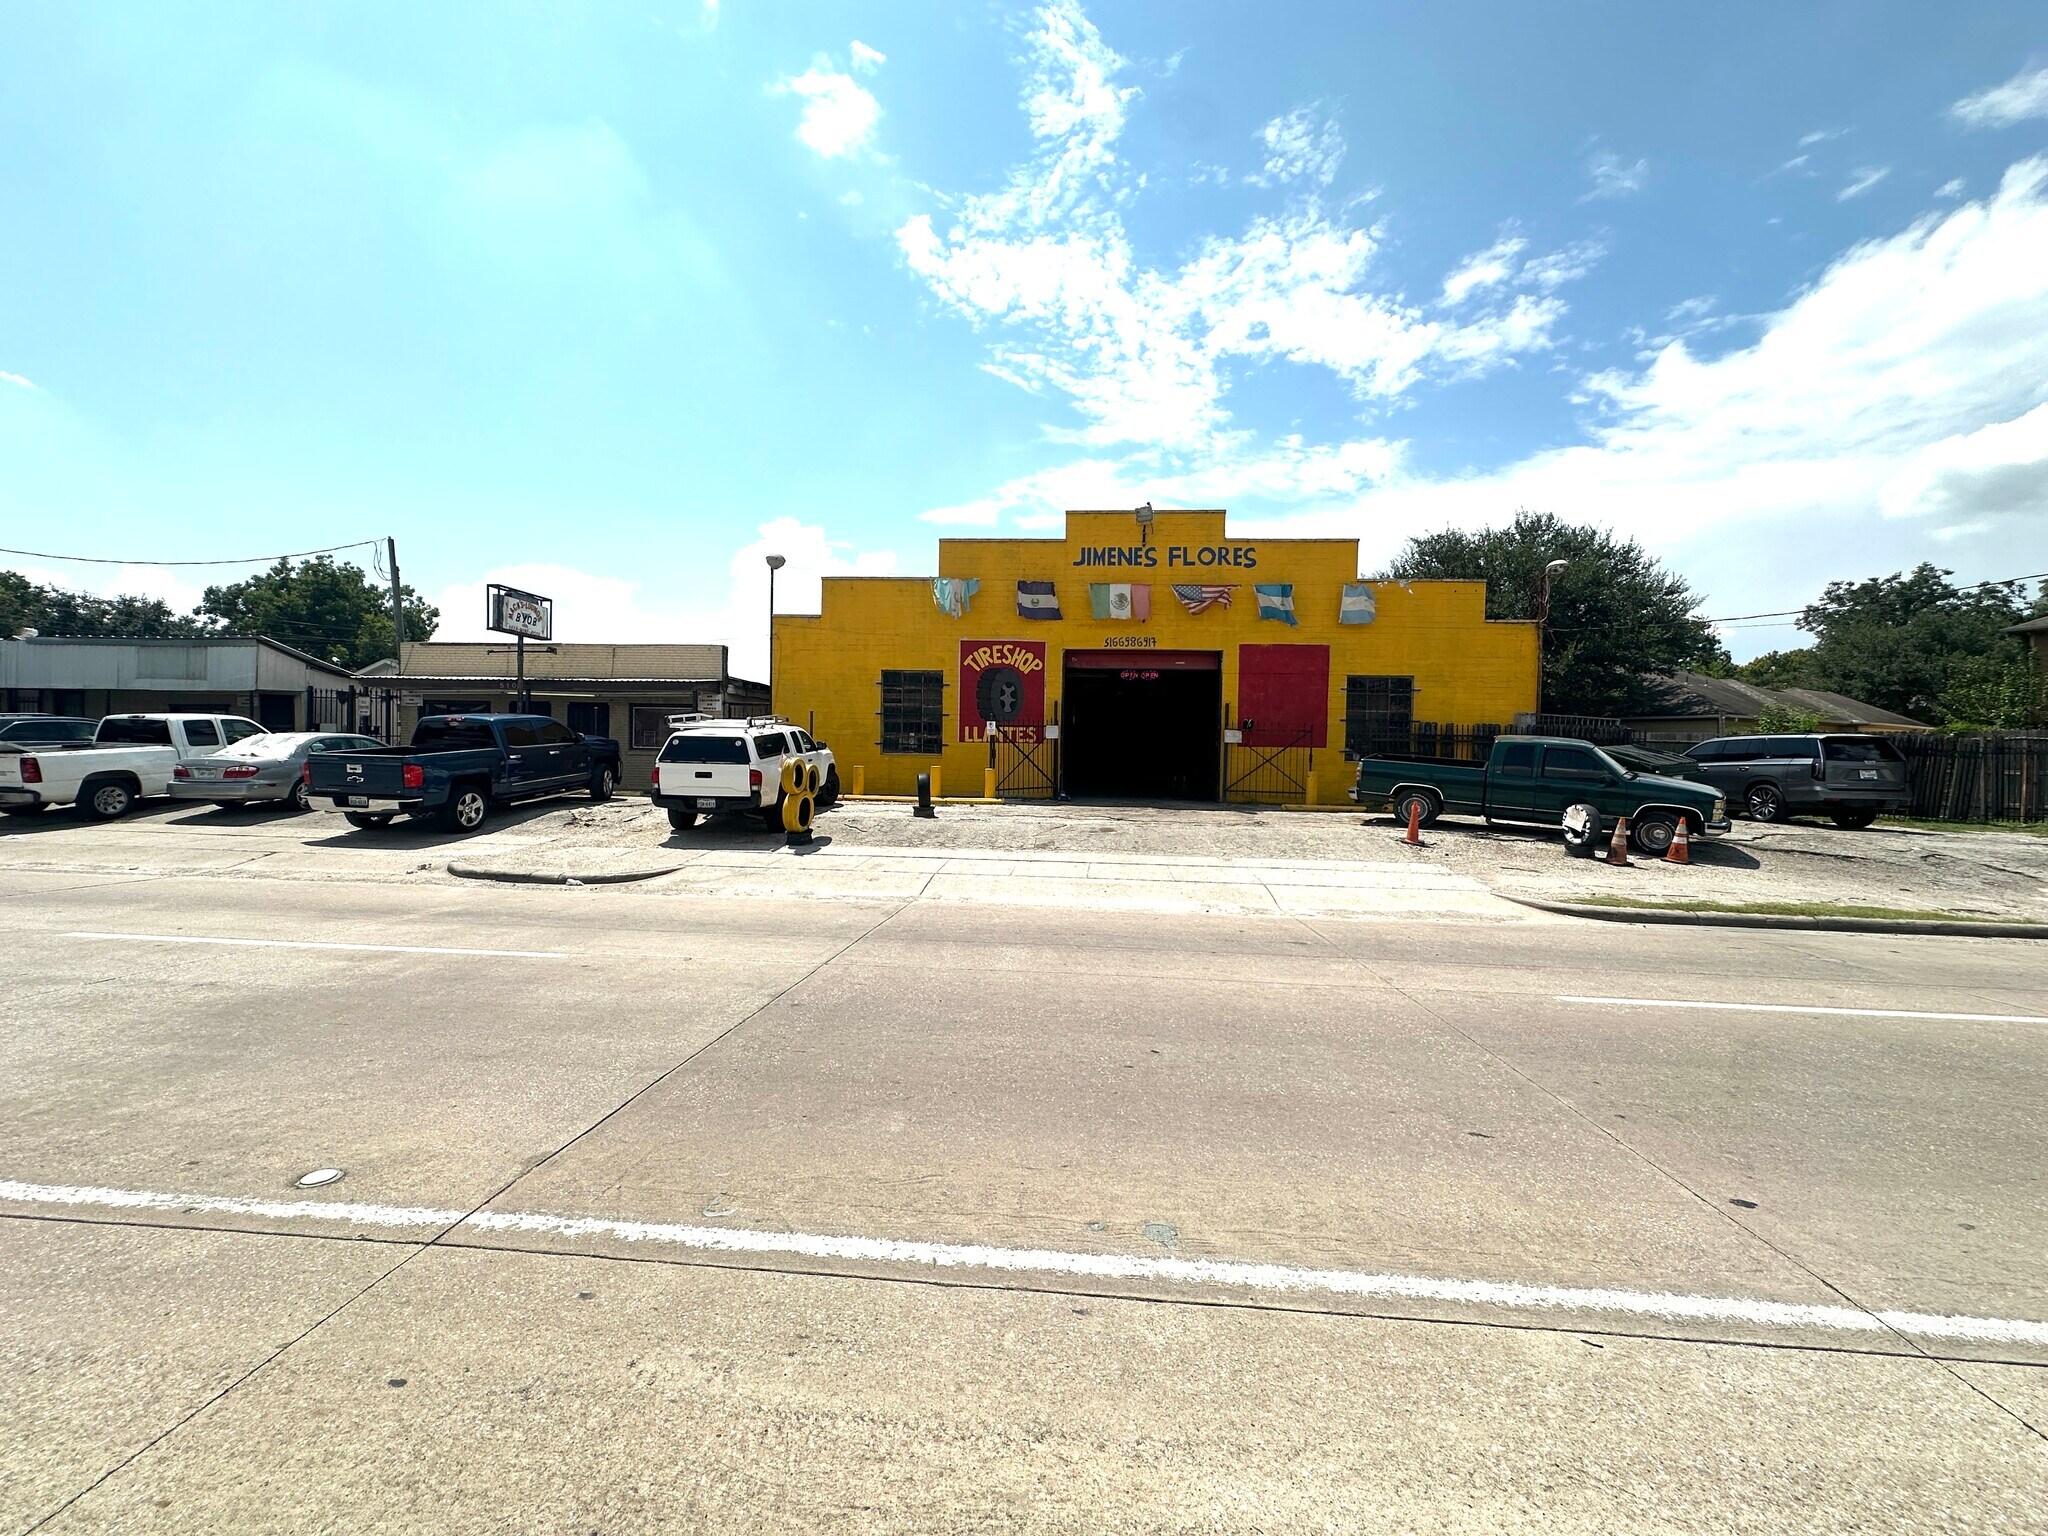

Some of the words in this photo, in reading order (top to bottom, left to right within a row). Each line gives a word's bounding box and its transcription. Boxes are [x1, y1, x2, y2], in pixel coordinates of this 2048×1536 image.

[1072, 546, 1158, 568] JIMENES
[1168, 546, 1257, 569] FLORES
[515, 612, 538, 627] BYOB
[963, 644, 1043, 675] TIRESHOP
